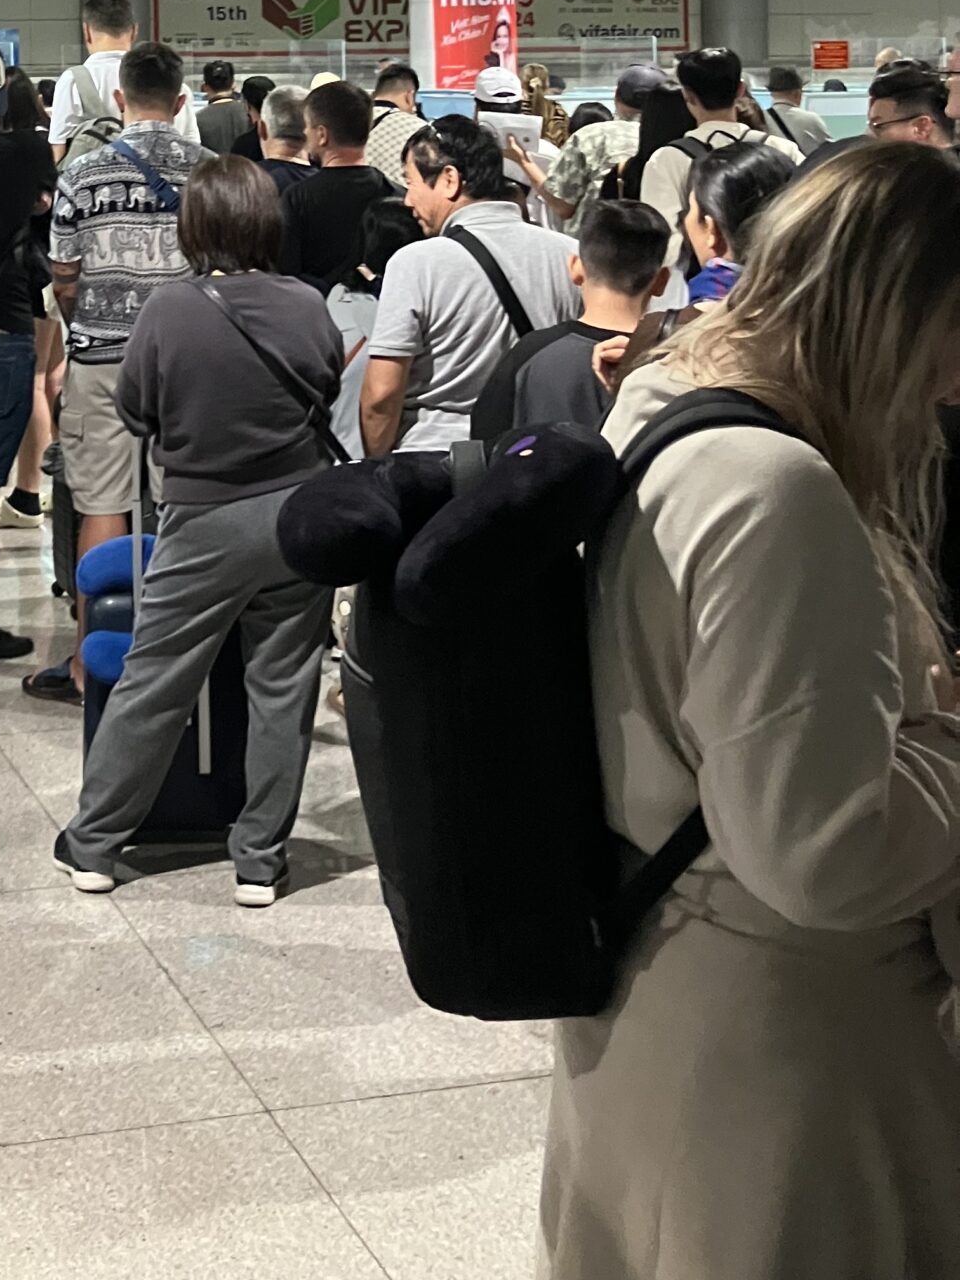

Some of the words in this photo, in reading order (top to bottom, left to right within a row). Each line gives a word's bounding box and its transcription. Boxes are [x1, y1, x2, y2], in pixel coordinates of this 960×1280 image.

[207, 6, 247, 21] 15th
[344, 19, 409, 42] EXP
[578, 23, 680, 39] vifafair.com
